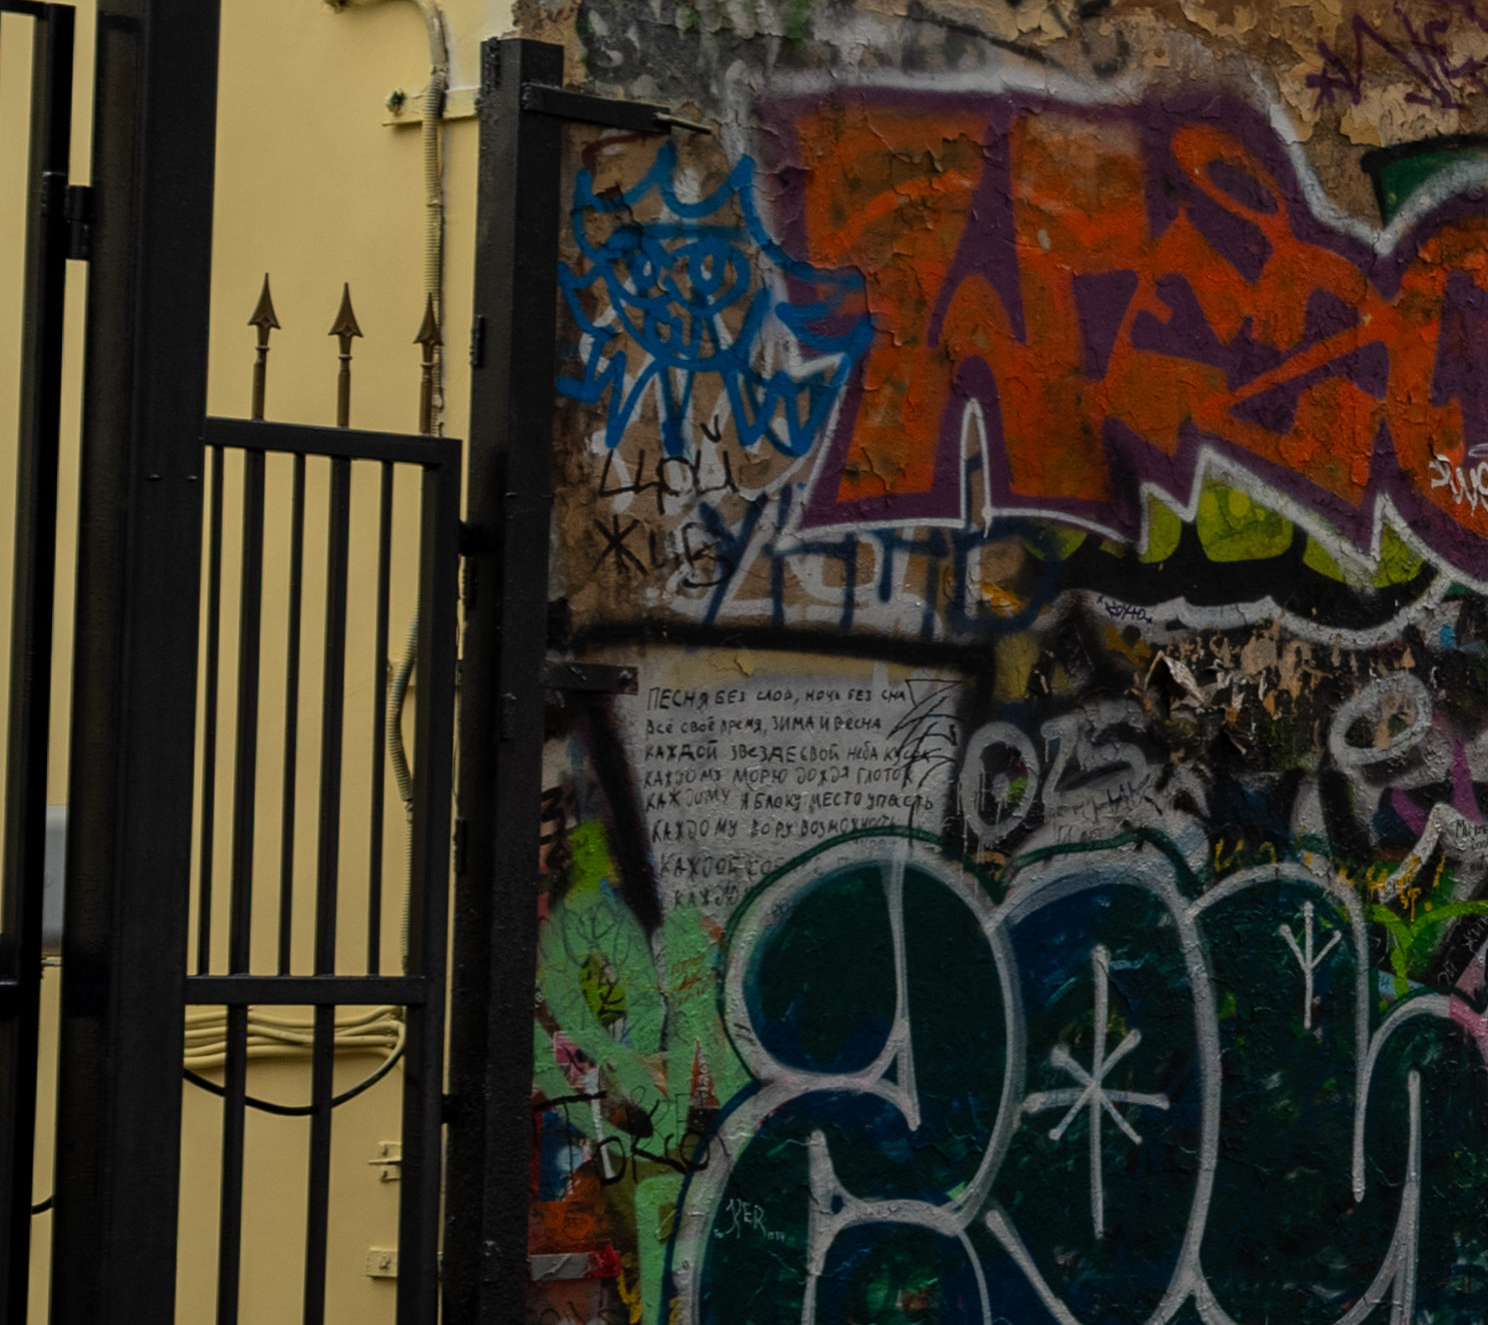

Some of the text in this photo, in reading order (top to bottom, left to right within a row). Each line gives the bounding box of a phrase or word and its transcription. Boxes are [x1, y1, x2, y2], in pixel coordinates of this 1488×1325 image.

[598, 413, 738, 515] ЦОЙ
[646, 686, 708, 711] ПЕСНЯ
[715, 689, 745, 705] БЕЗ
[805, 688, 841, 702] НОЧЬ
[847, 688, 872, 702] БЕЗ
[881, 688, 906, 703] СНА
[819, 715, 830, 731] И
[644, 739, 718, 763] КАЖДОЙ
[731, 766, 789, 785] МОРЮ
[810, 790, 863, 811] МЕСТО
